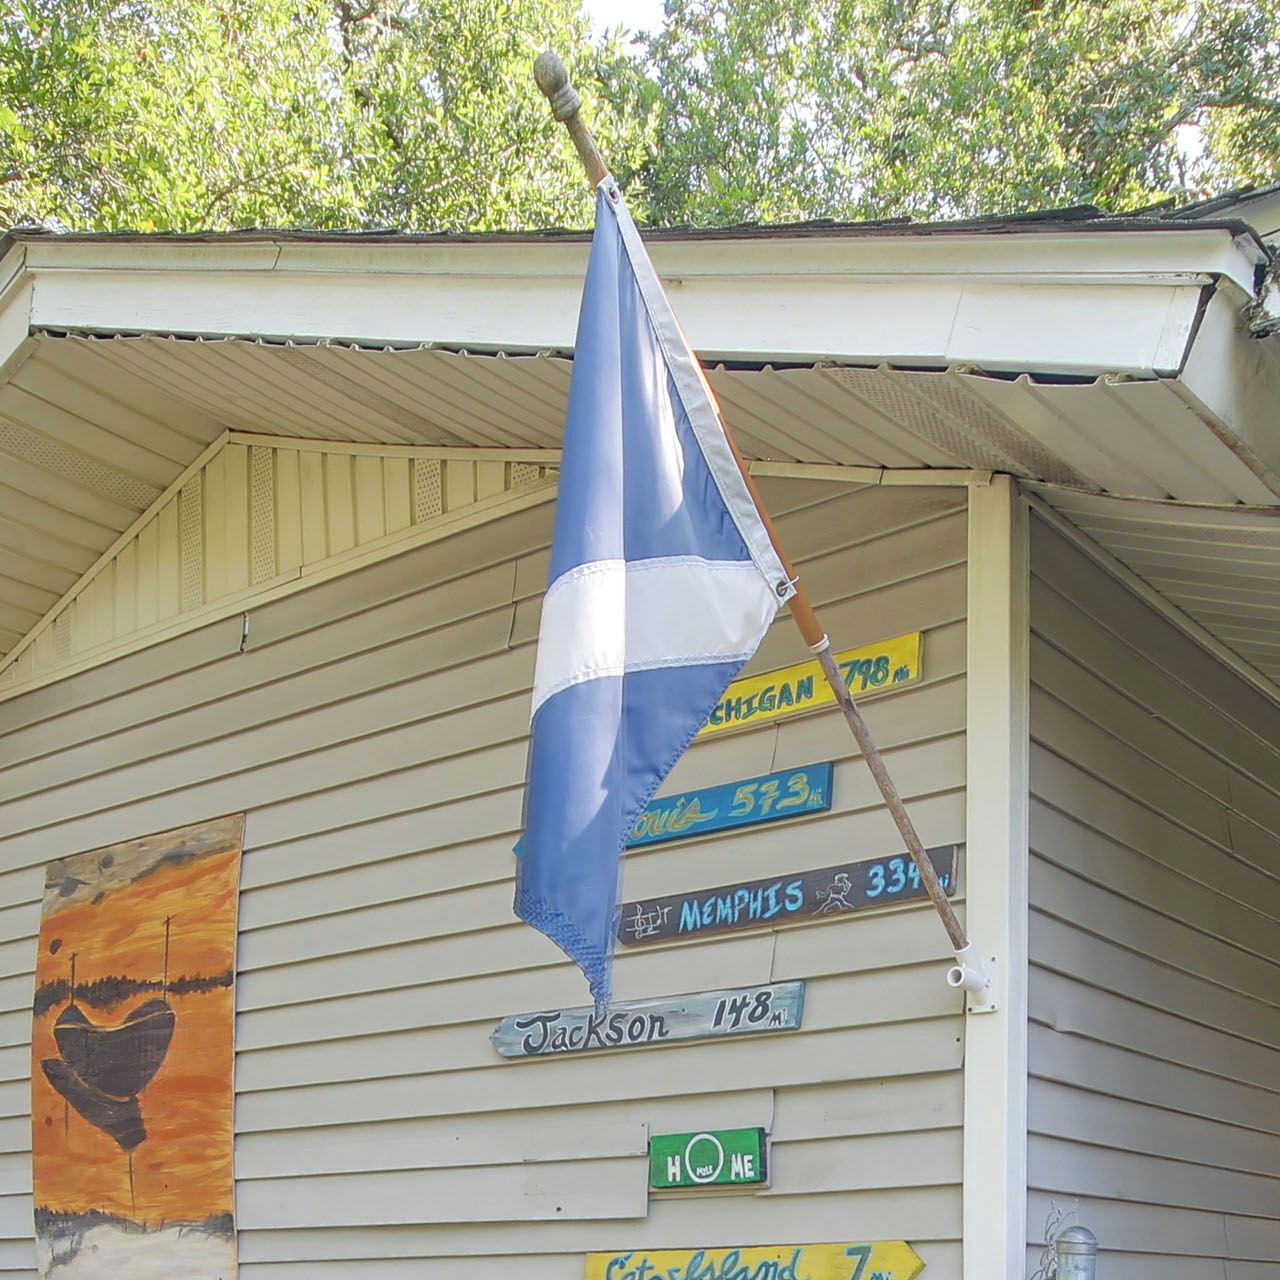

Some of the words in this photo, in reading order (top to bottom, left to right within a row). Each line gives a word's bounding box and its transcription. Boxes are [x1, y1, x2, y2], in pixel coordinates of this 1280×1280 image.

[704, 675, 814, 726] CHIGAN
[838, 655, 890, 690] 798
[630, 797, 719, 839] ouis
[728, 772, 810, 817] 573
[679, 879, 804, 934] MEMPHIS
[866, 857, 921, 899] 334
[515, 1010, 670, 1053] Jackson
[711, 990, 774, 1032] 148
